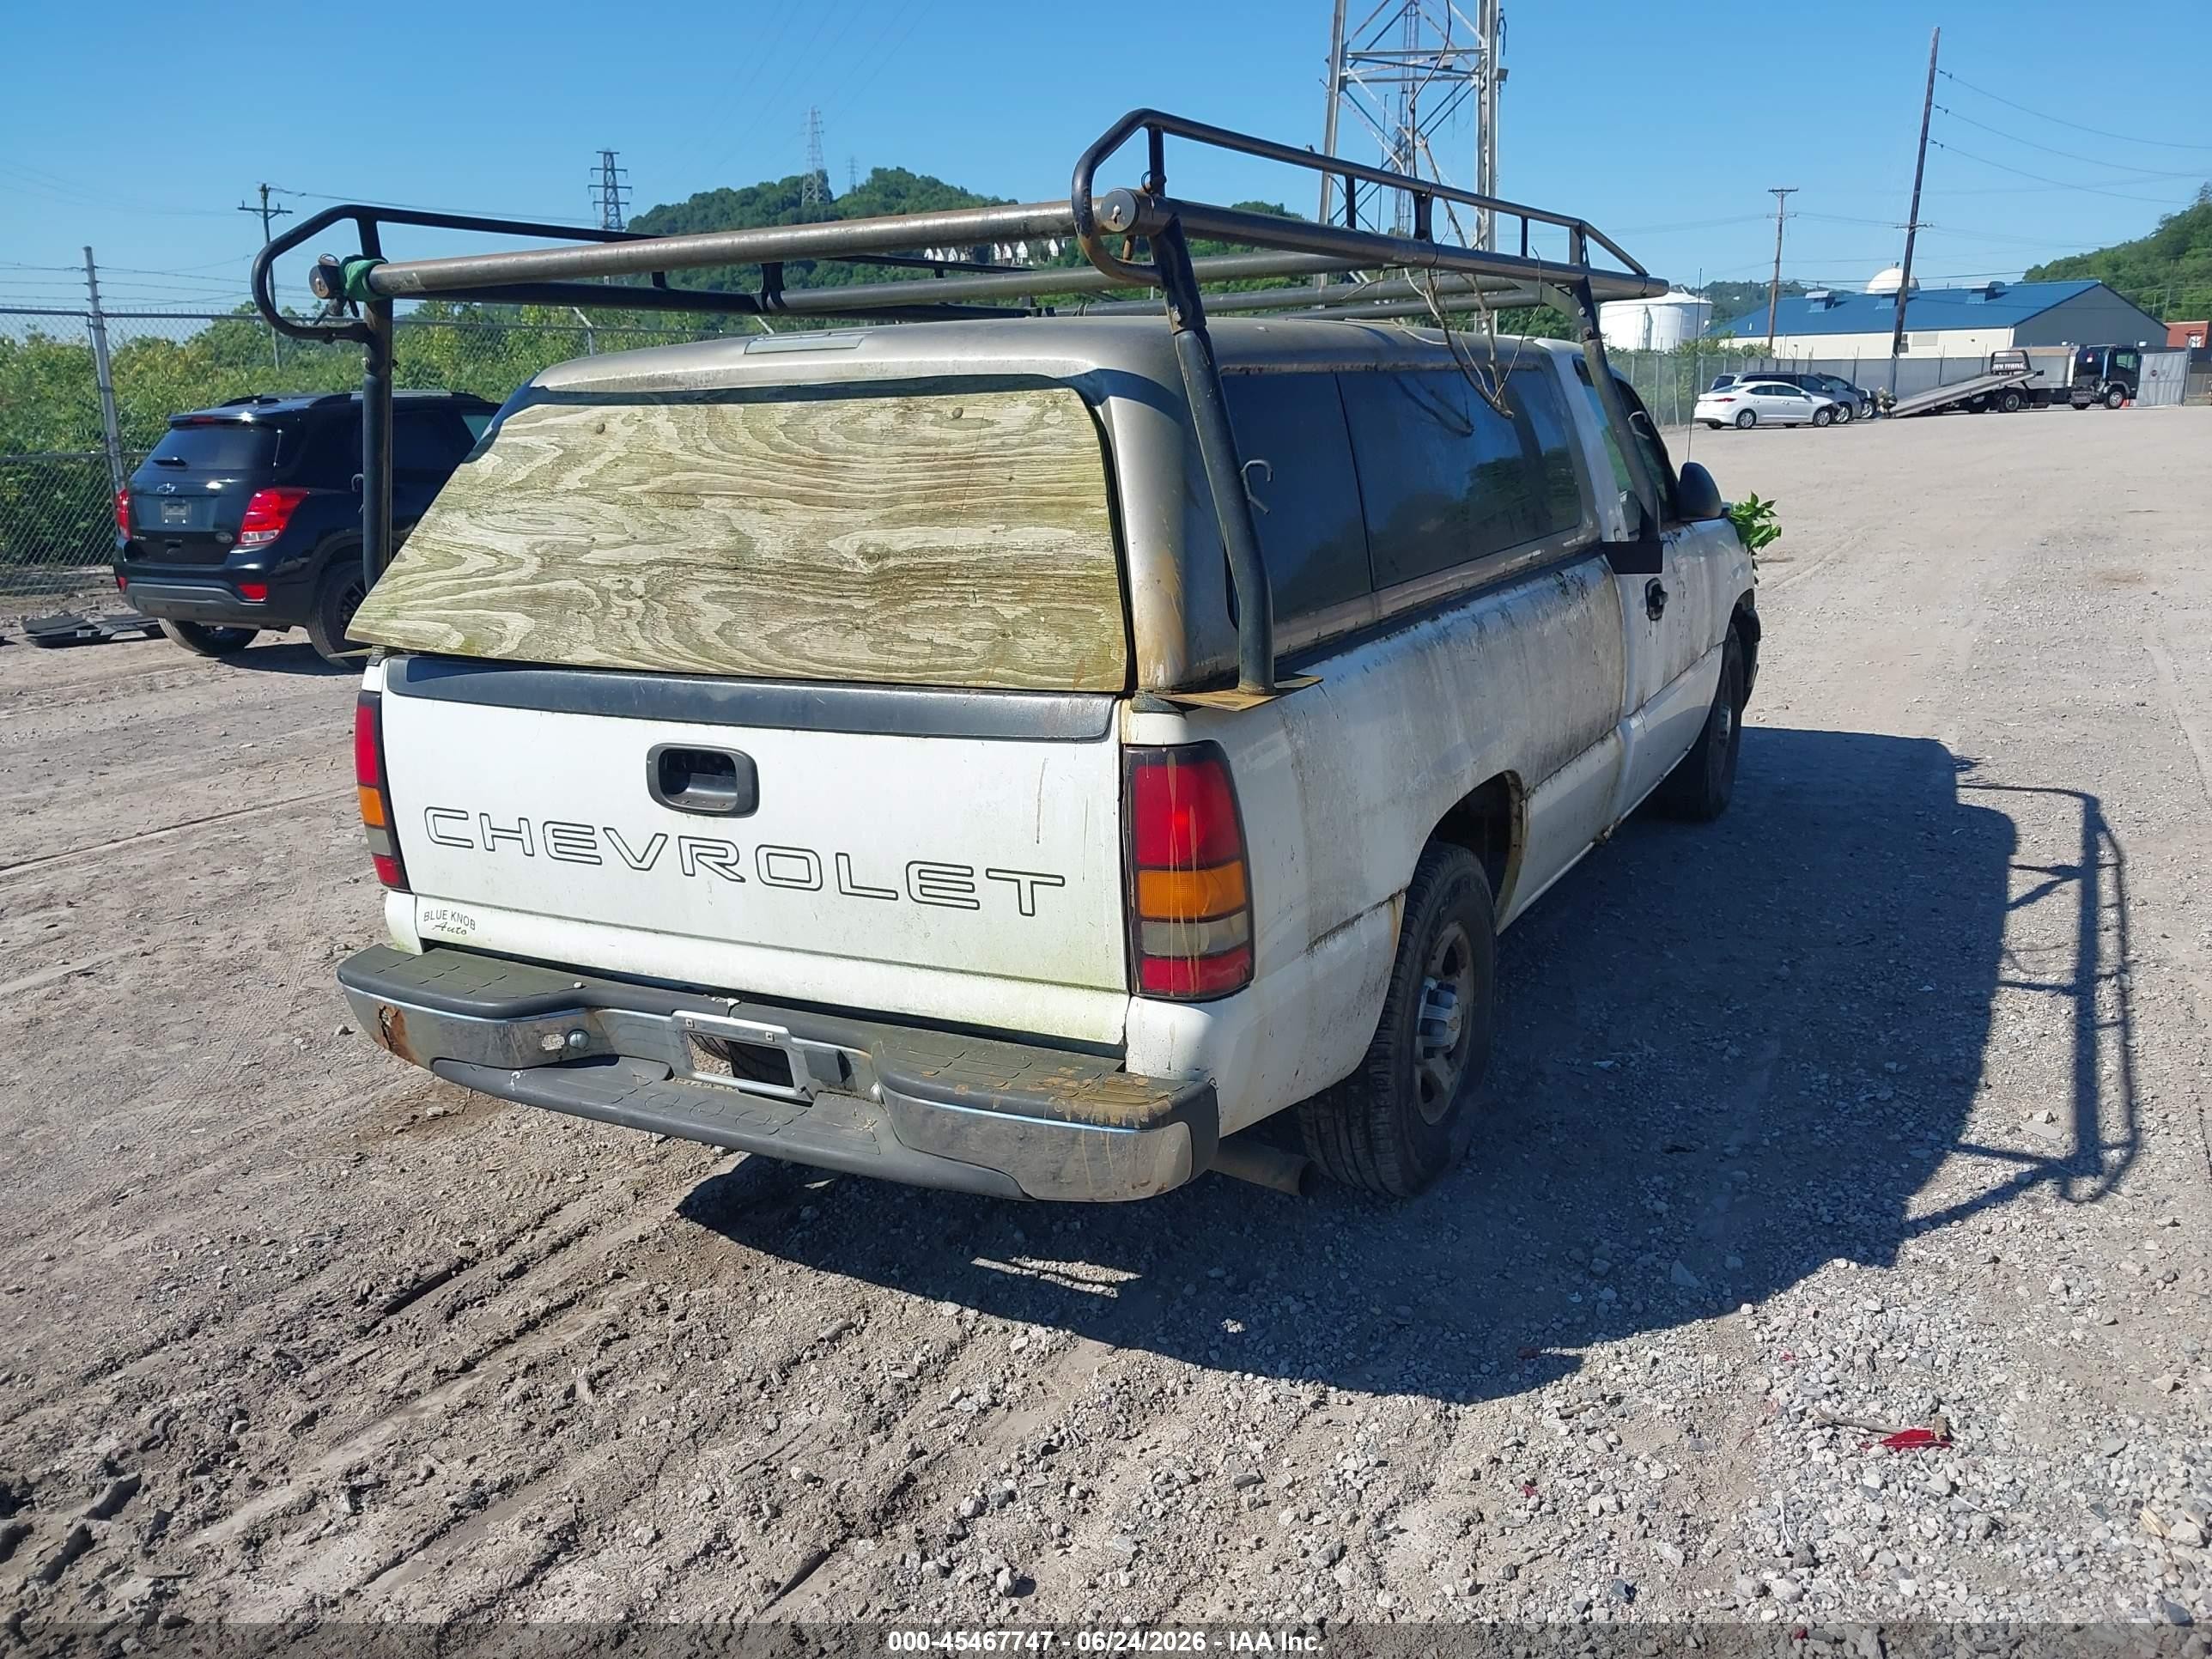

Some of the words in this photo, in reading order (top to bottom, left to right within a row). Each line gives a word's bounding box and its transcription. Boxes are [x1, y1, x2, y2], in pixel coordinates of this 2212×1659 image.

[424, 806, 1066, 917] CHEVROLET
[423, 909, 448, 922] BLUE
[450, 909, 476, 931] KNOB
[432, 921, 467, 935] Auto
